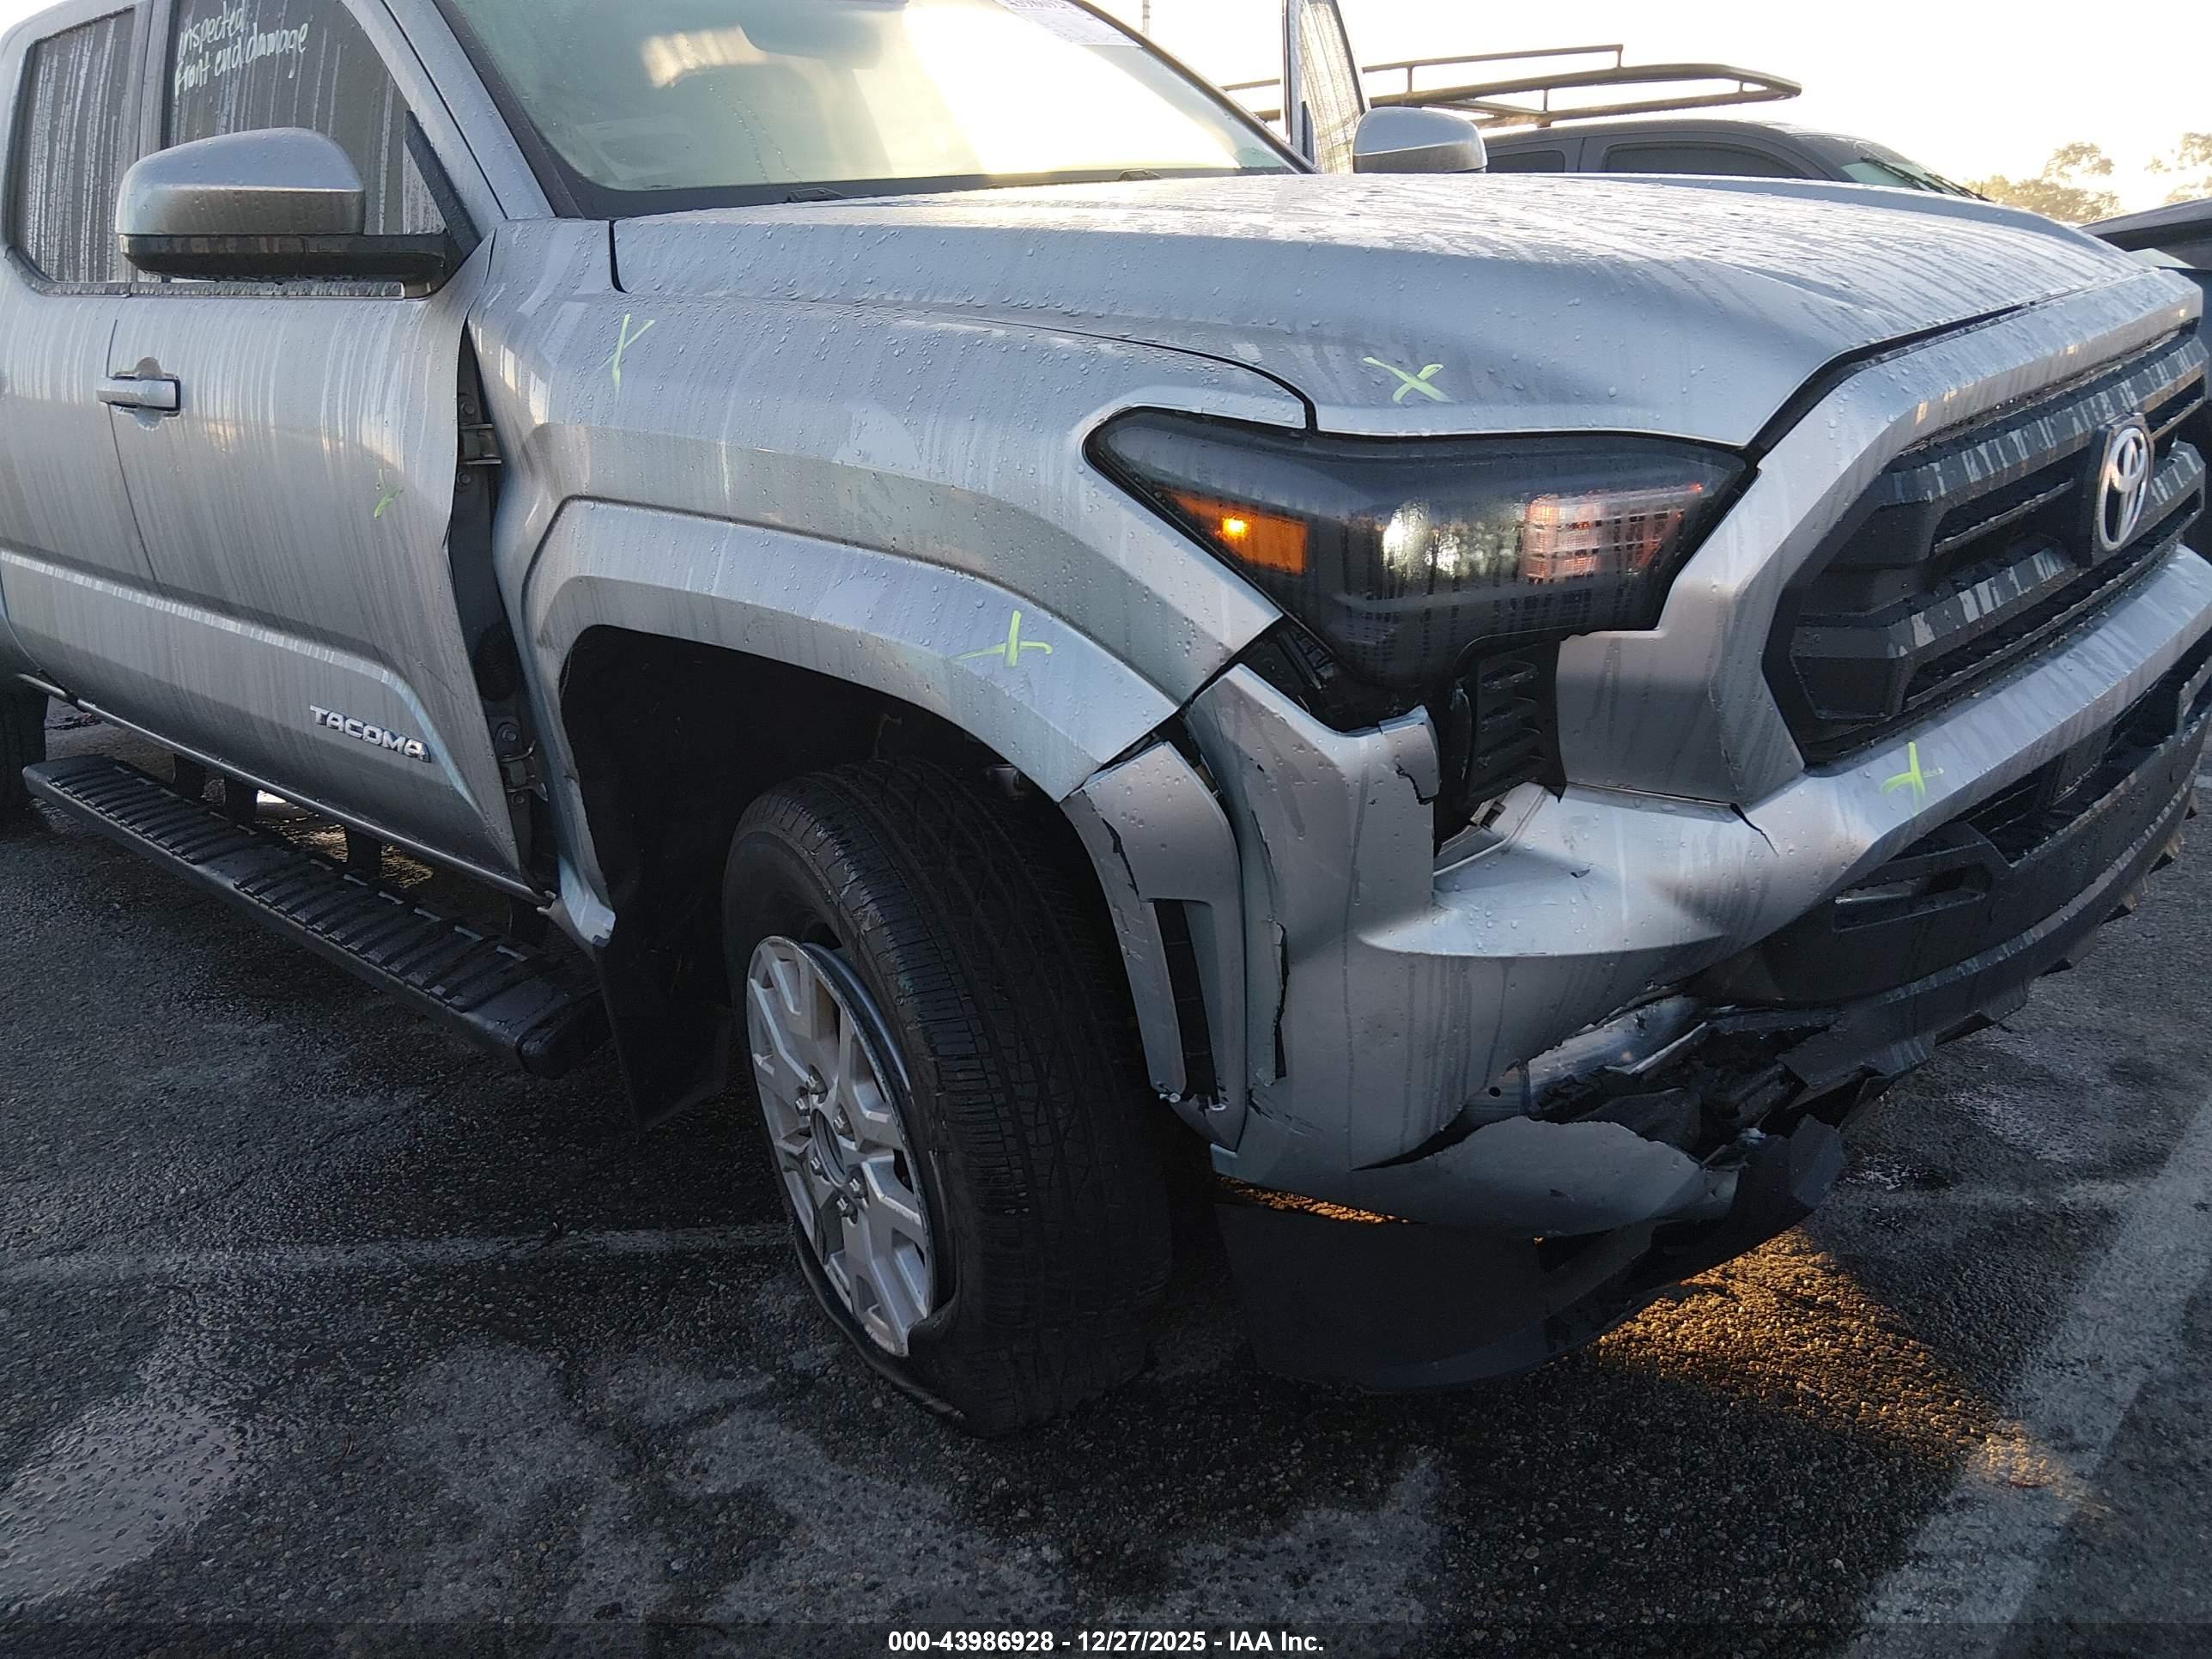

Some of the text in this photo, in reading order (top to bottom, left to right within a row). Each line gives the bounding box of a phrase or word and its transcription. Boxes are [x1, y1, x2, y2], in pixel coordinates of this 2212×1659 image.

[174, 22, 308, 101] front end damage
[309, 704, 431, 763] TACOMA
